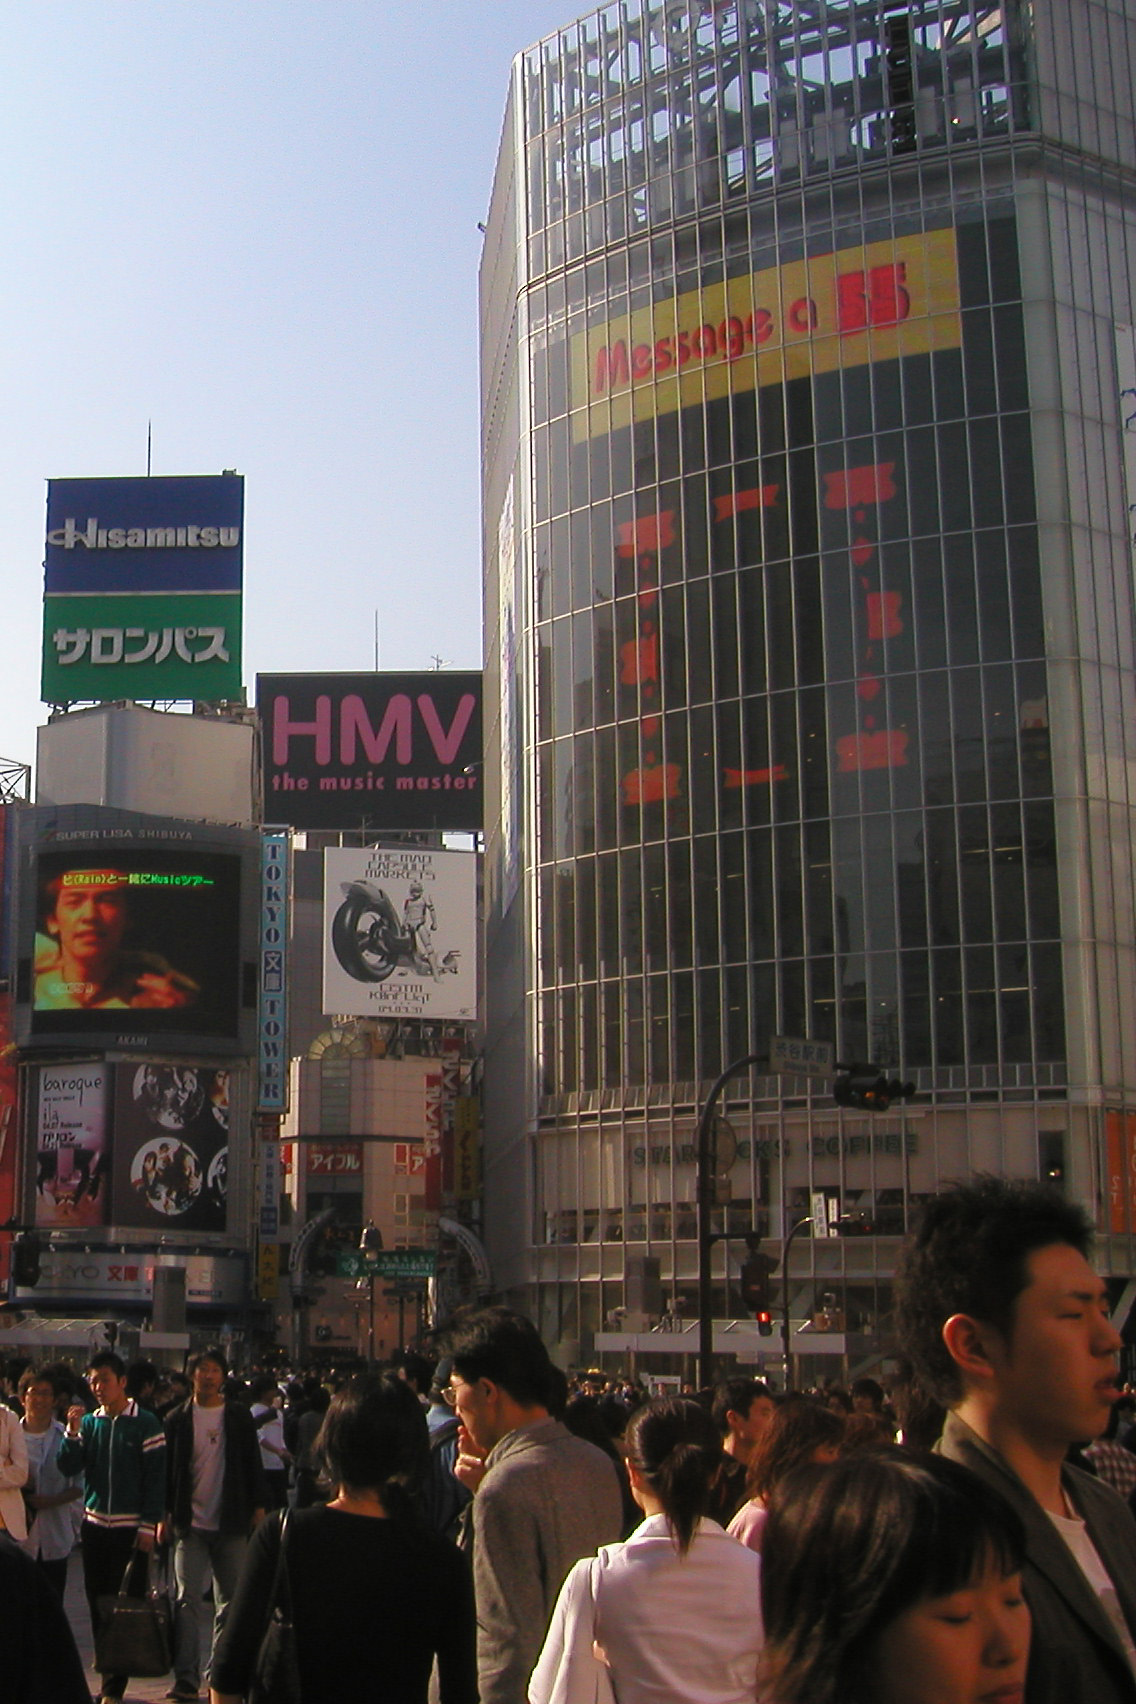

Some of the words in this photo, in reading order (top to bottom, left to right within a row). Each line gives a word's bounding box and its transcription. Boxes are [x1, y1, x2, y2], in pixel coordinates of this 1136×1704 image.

[596, 308, 775, 392] Message
[789, 296, 819, 333] a
[52, 626, 230, 665] サロンパス
[272, 693, 476, 766] HMV
[272, 772, 310, 791] the
[320, 771, 385, 791] music
[396, 773, 477, 790] master
[56, 830, 100, 841] SUPER
[103, 829, 134, 839] LISA
[138, 830, 193, 840] SHIBUYA
[265, 844, 281, 943] TOKYO
[264, 1000, 281, 1099] TOWER
[43, 1073, 102, 1106] baroque
[311, 1152, 360, 1171] アイフル
[633, 1139, 790, 1168] STARCKS
[808, 1134, 919, 1157] COFFEE
